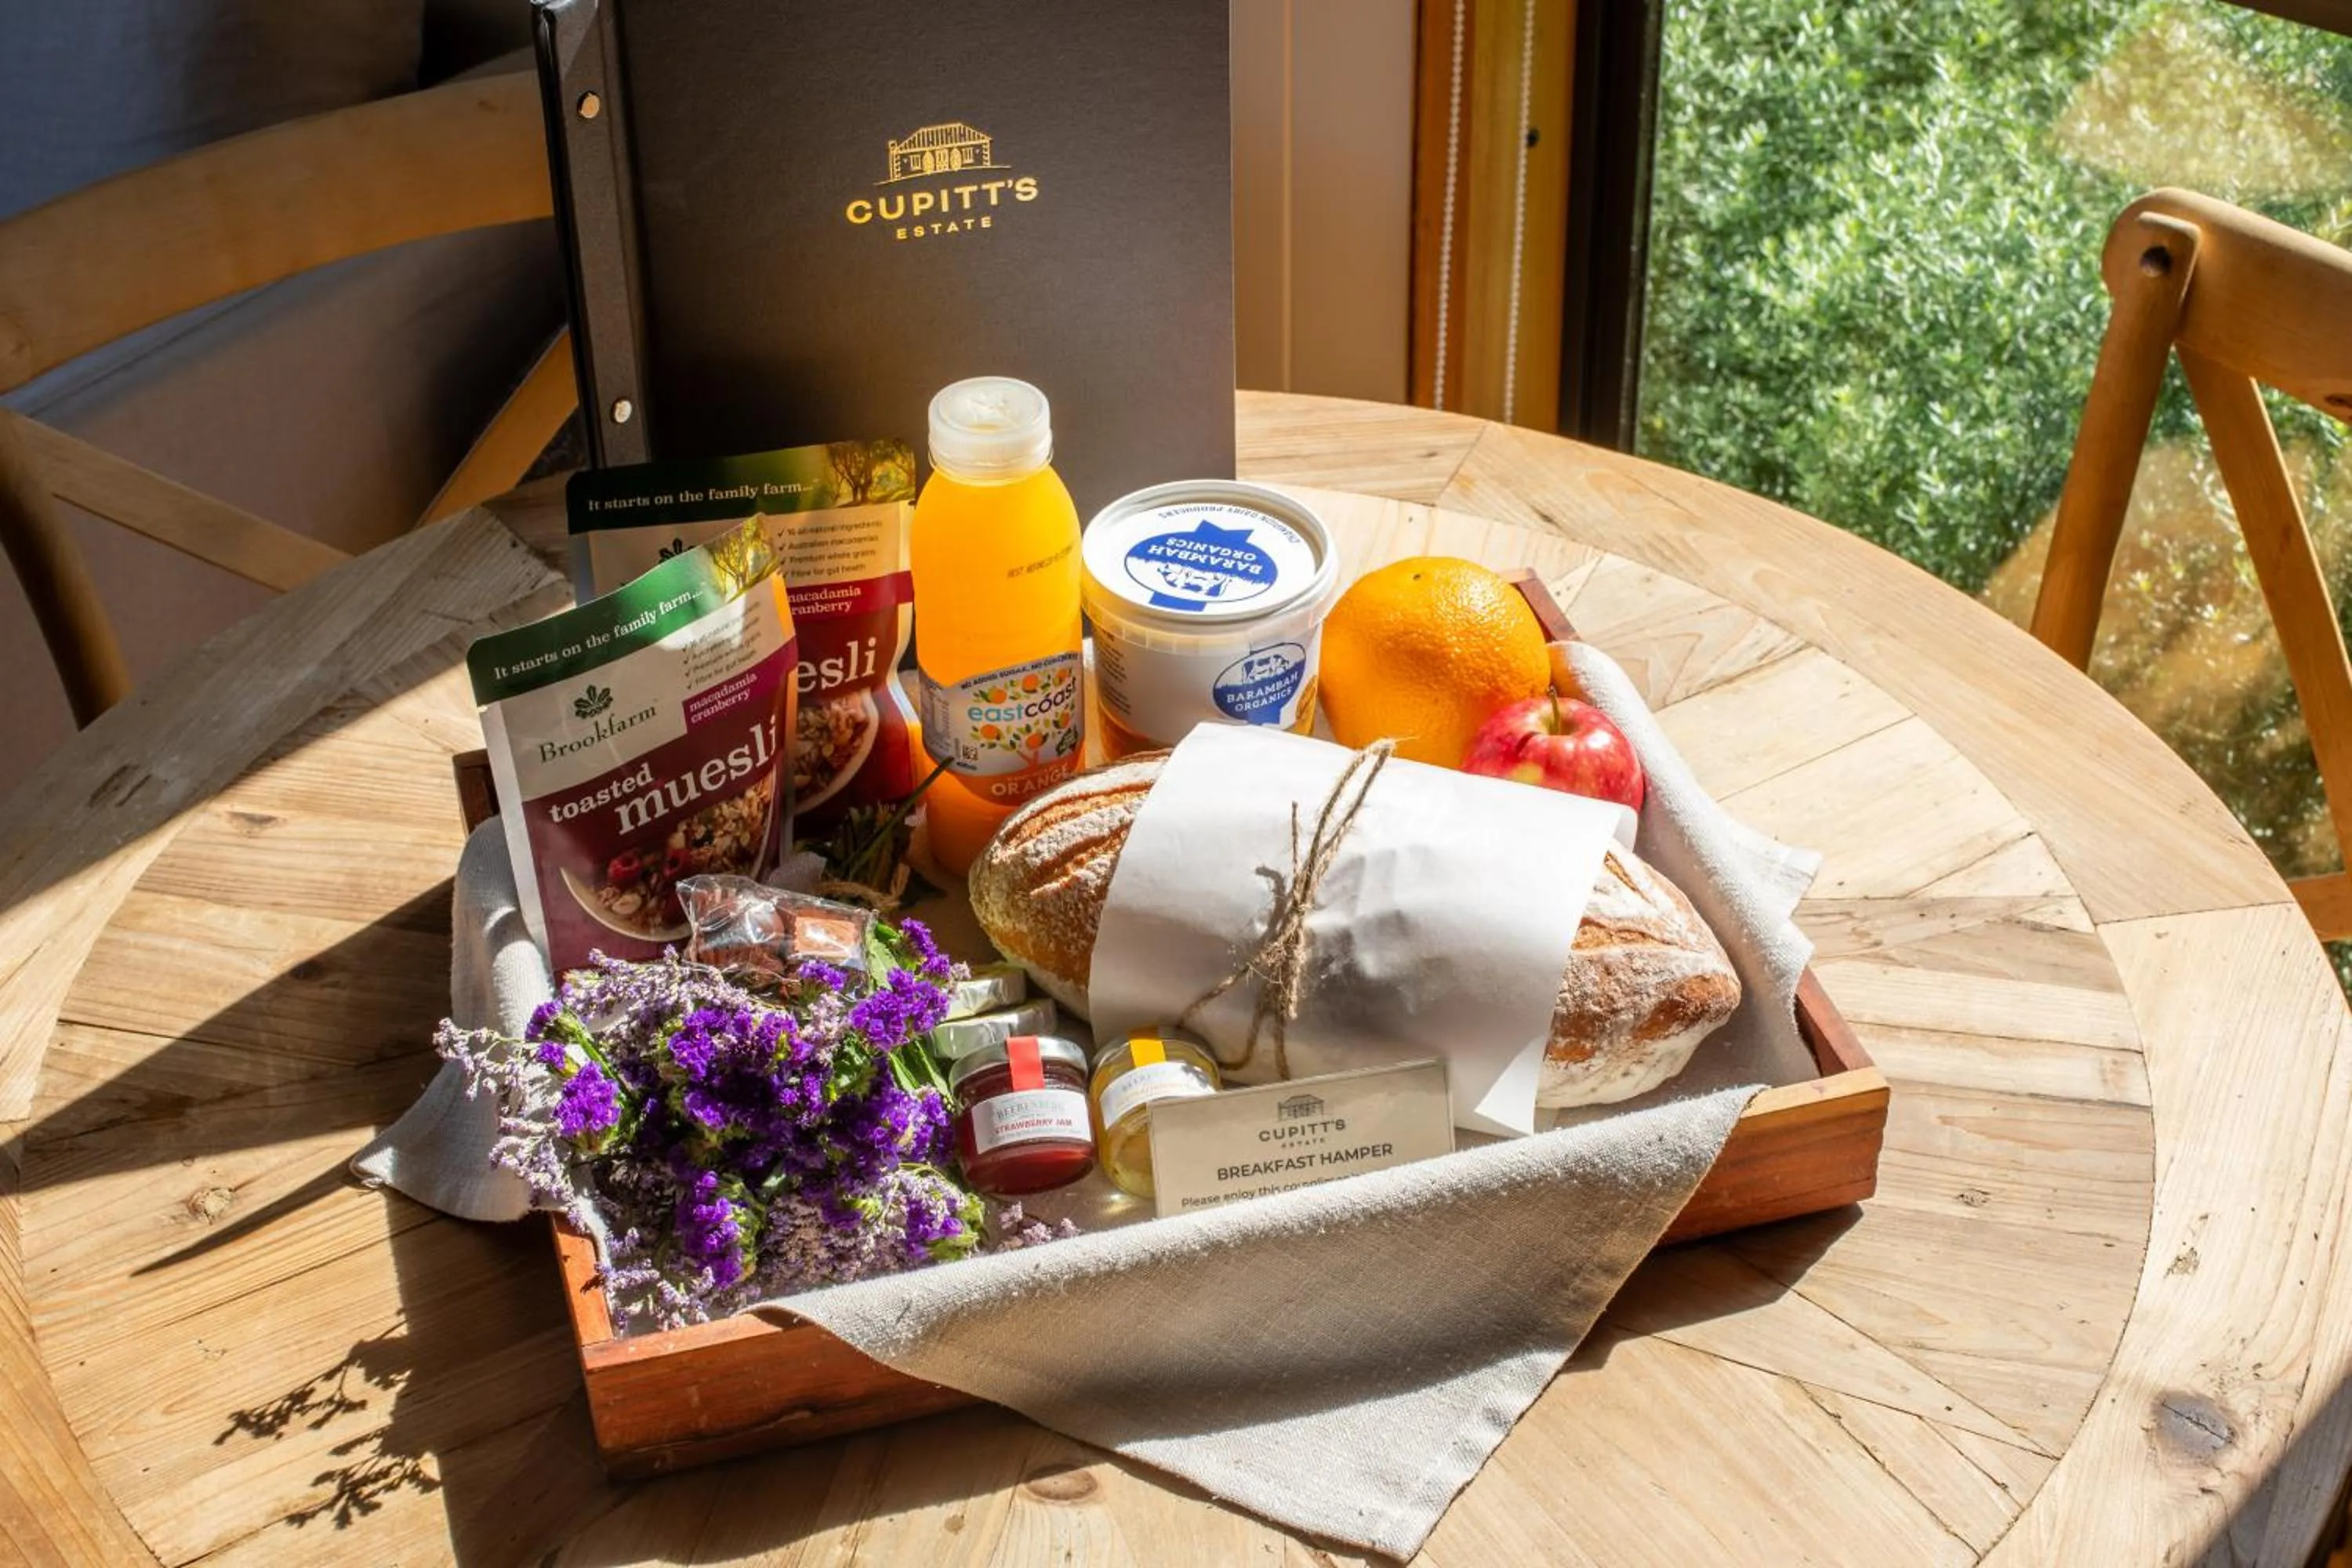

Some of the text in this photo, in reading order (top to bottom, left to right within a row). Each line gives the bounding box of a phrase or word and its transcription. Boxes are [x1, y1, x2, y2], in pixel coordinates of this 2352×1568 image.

[846, 176, 1038, 224] CUPITT'S
[896, 216, 992, 240] ESTATE
[588, 499, 601, 511] It
[604, 495, 651, 510] starts
[654, 493, 673, 505] on
[679, 490, 704, 503] the
[708, 485, 758, 501] family
[1148, 544, 1264, 575] BARAMBAH
[1165, 536, 1258, 562] ORGANICS
[790, 600, 852, 616] ranberry
[494, 666, 508, 681] It
[512, 651, 559, 675] starts
[561, 643, 583, 659] on
[586, 630, 612, 649] the
[613, 608, 658, 639] family
[797, 637, 877, 693] esli
[689, 673, 758, 713] macadamia
[1227, 670, 1298, 704] BARAMBAH
[1235, 686, 1293, 713] ORGANICS
[690, 688, 751, 724] cranberry
[539, 705, 658, 764] Brookfarm
[614, 714, 777, 837] muesli
[549, 762, 655, 824] toasted
[994, 1119, 1053, 1134] STRAWBERRY
[1258, 1119, 1346, 1142] CUPITT'S
[1217, 1143, 1393, 1181] BREAKFAST HAMPER
[1181, 1194, 1221, 1207] Please
[1223, 1188, 1256, 1203] enjoy
